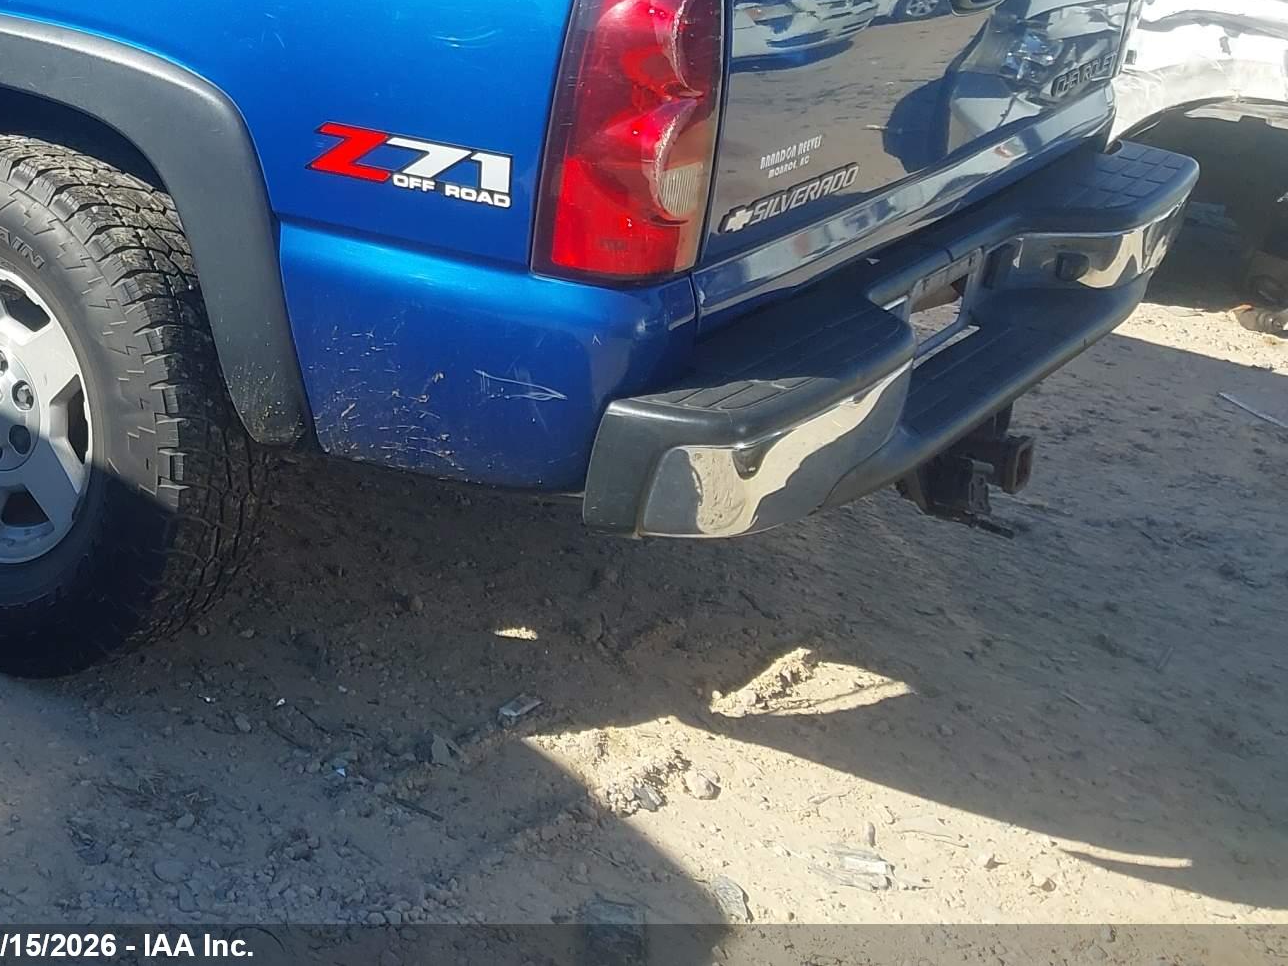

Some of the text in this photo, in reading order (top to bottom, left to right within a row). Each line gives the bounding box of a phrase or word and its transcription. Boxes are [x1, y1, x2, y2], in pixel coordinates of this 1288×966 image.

[307, 121, 513, 195] Z71
[392, 173, 512, 209] OFF ROAD
[749, 165, 860, 225] SILVERADO
